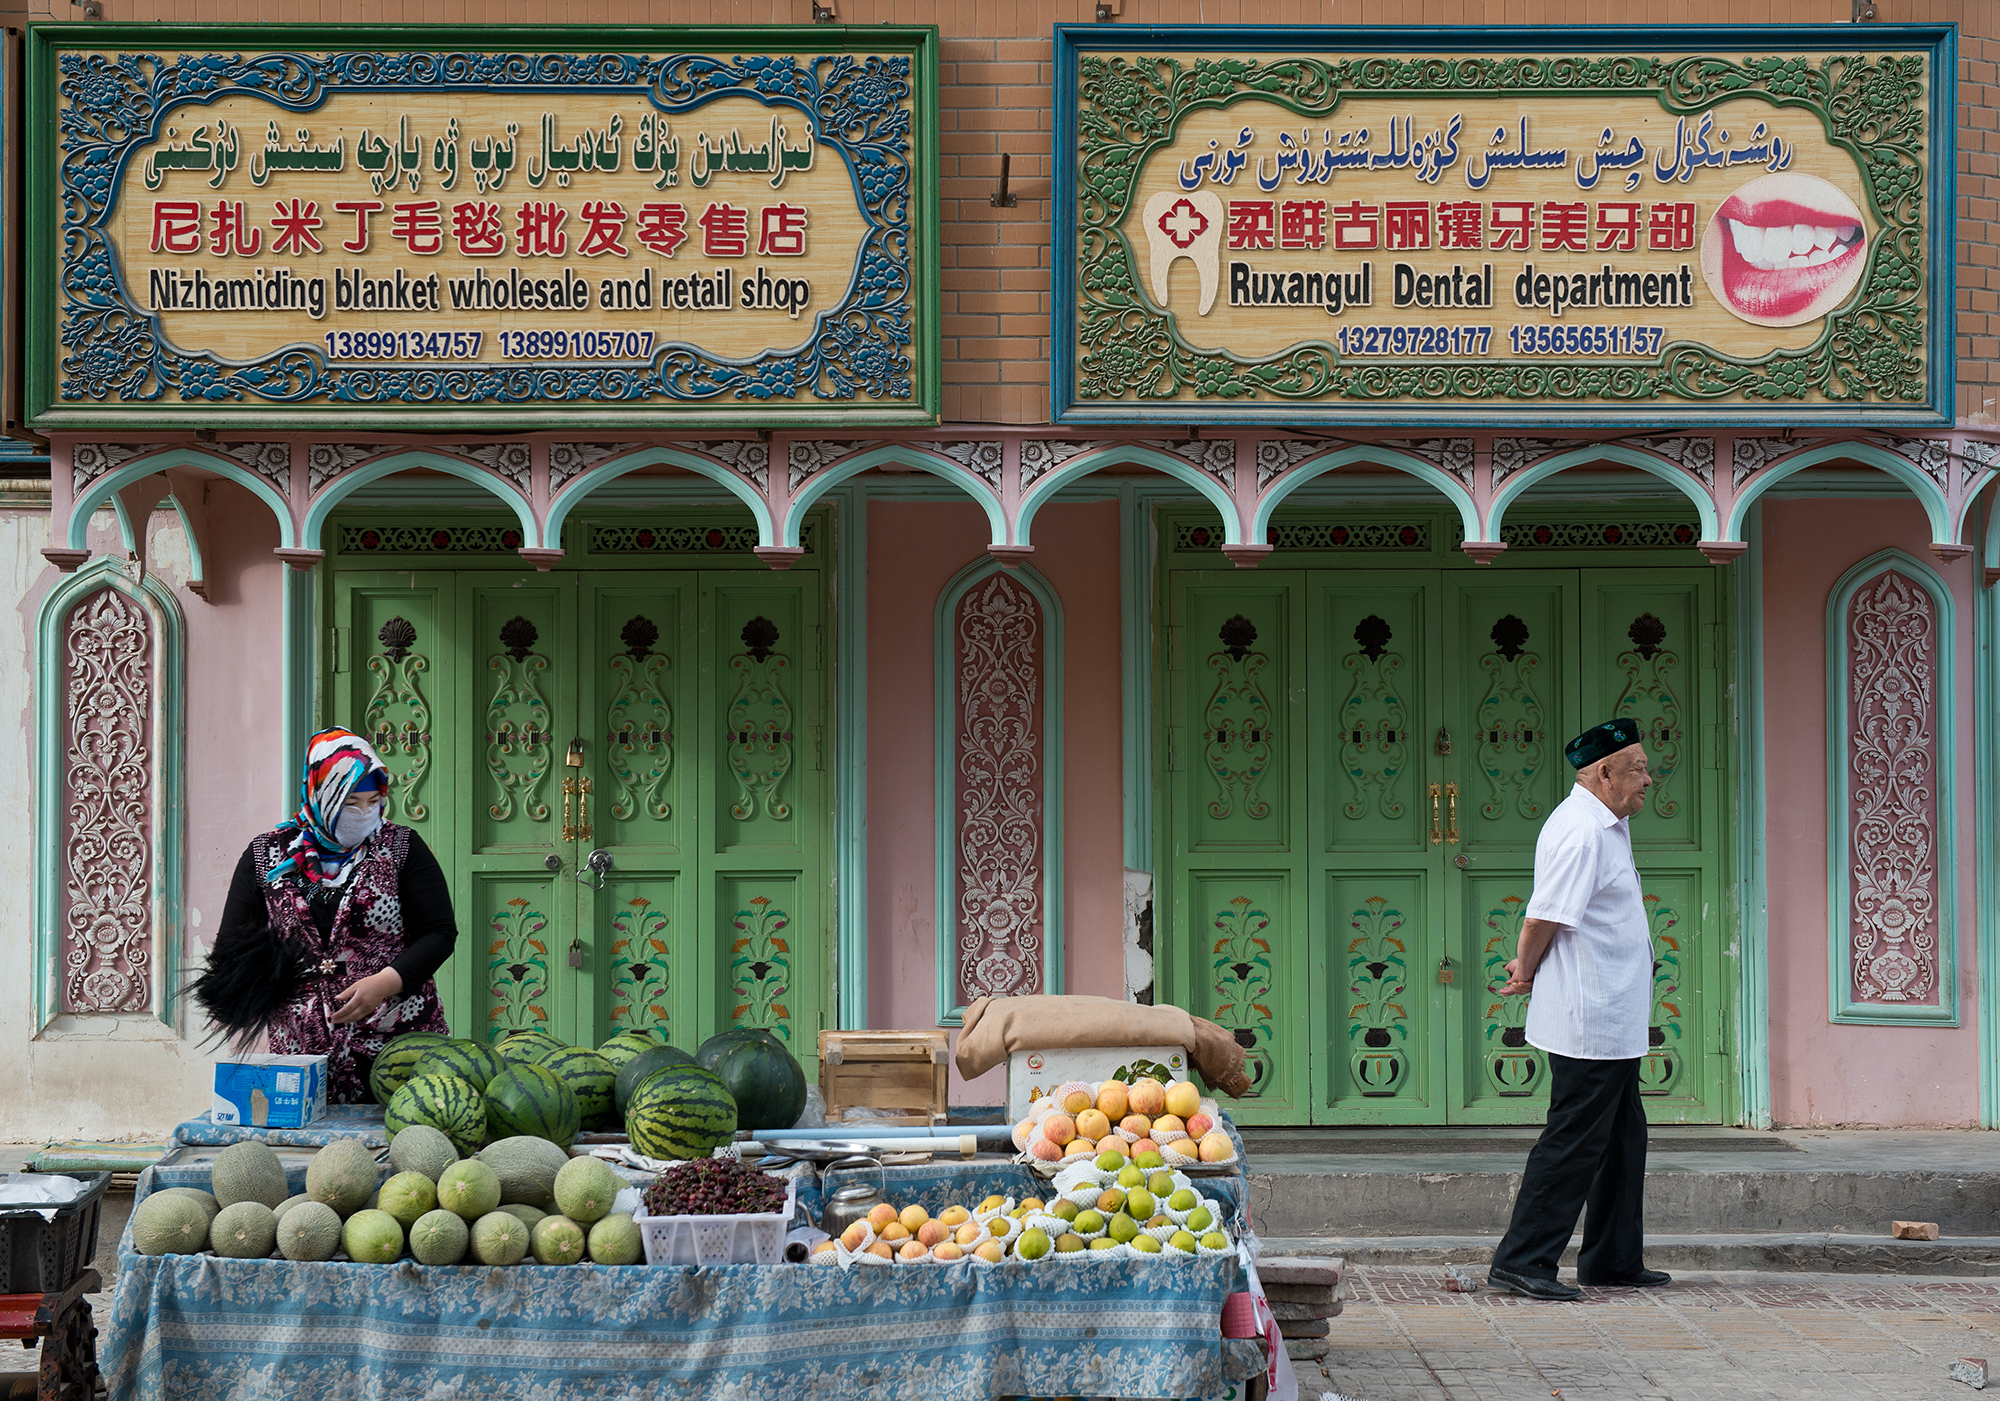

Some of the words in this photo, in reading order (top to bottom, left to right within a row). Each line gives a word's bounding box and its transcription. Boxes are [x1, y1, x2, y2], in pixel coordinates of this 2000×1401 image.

[150, 198, 805, 256] 尼扎米丁毛毯批发零售店
[1229, 200, 1695, 250] 柔鲜古丽镶牙美牙部
[147, 269, 324, 321] Nizhamiding
[335, 268, 438, 313] blanket
[448, 268, 588, 312] wholesale
[600, 268, 651, 312] and
[662, 268, 730, 308] retail
[741, 267, 809, 315] shop
[1230, 262, 1370, 314] Ruxangul
[1394, 263, 1491, 306] Dental
[1515, 264, 1691, 314] department
[324, 332, 481, 361] 13899134757
[500, 331, 653, 356] 13899105707
[1338, 326, 1492, 353] 13279728177
[1510, 325, 1663, 353] 13565651157
